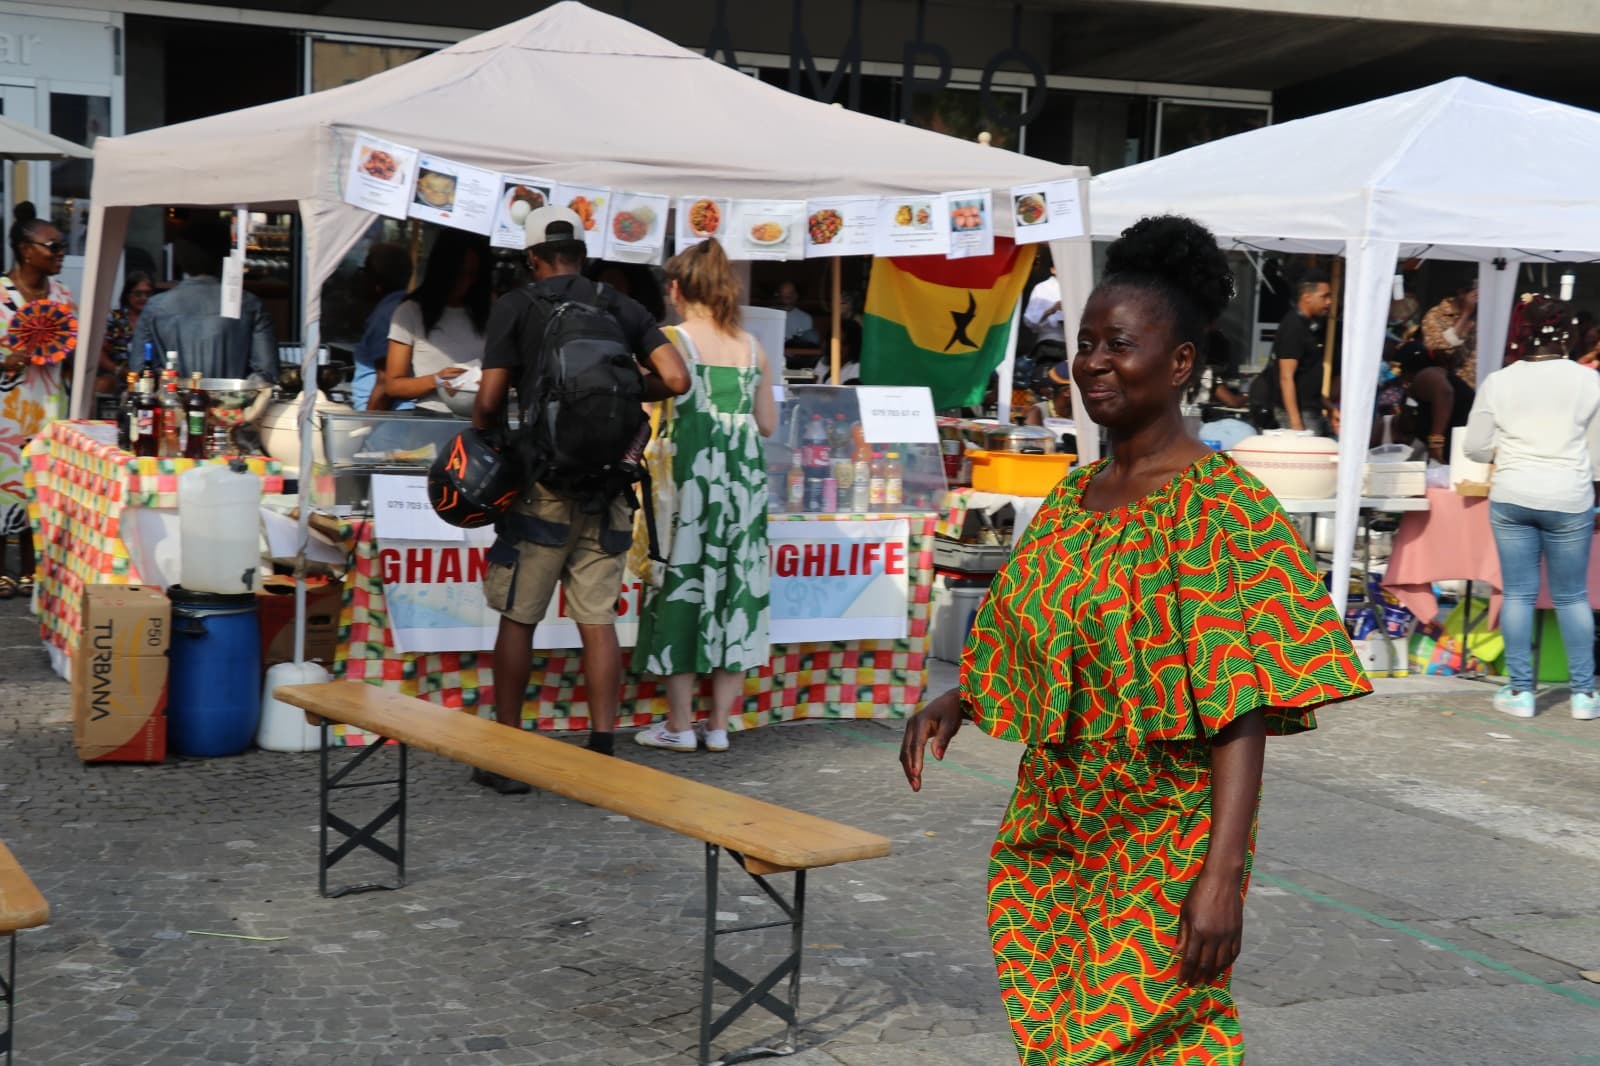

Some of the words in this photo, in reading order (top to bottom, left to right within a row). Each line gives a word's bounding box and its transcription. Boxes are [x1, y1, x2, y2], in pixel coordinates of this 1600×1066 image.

[705, 27, 1047, 127] AMPO
[380, 547, 490, 584] GHAN
[769, 543, 905, 577] GHLIFE
[148, 617, 162, 647] P50
[91, 619, 113, 721] TURBANA
